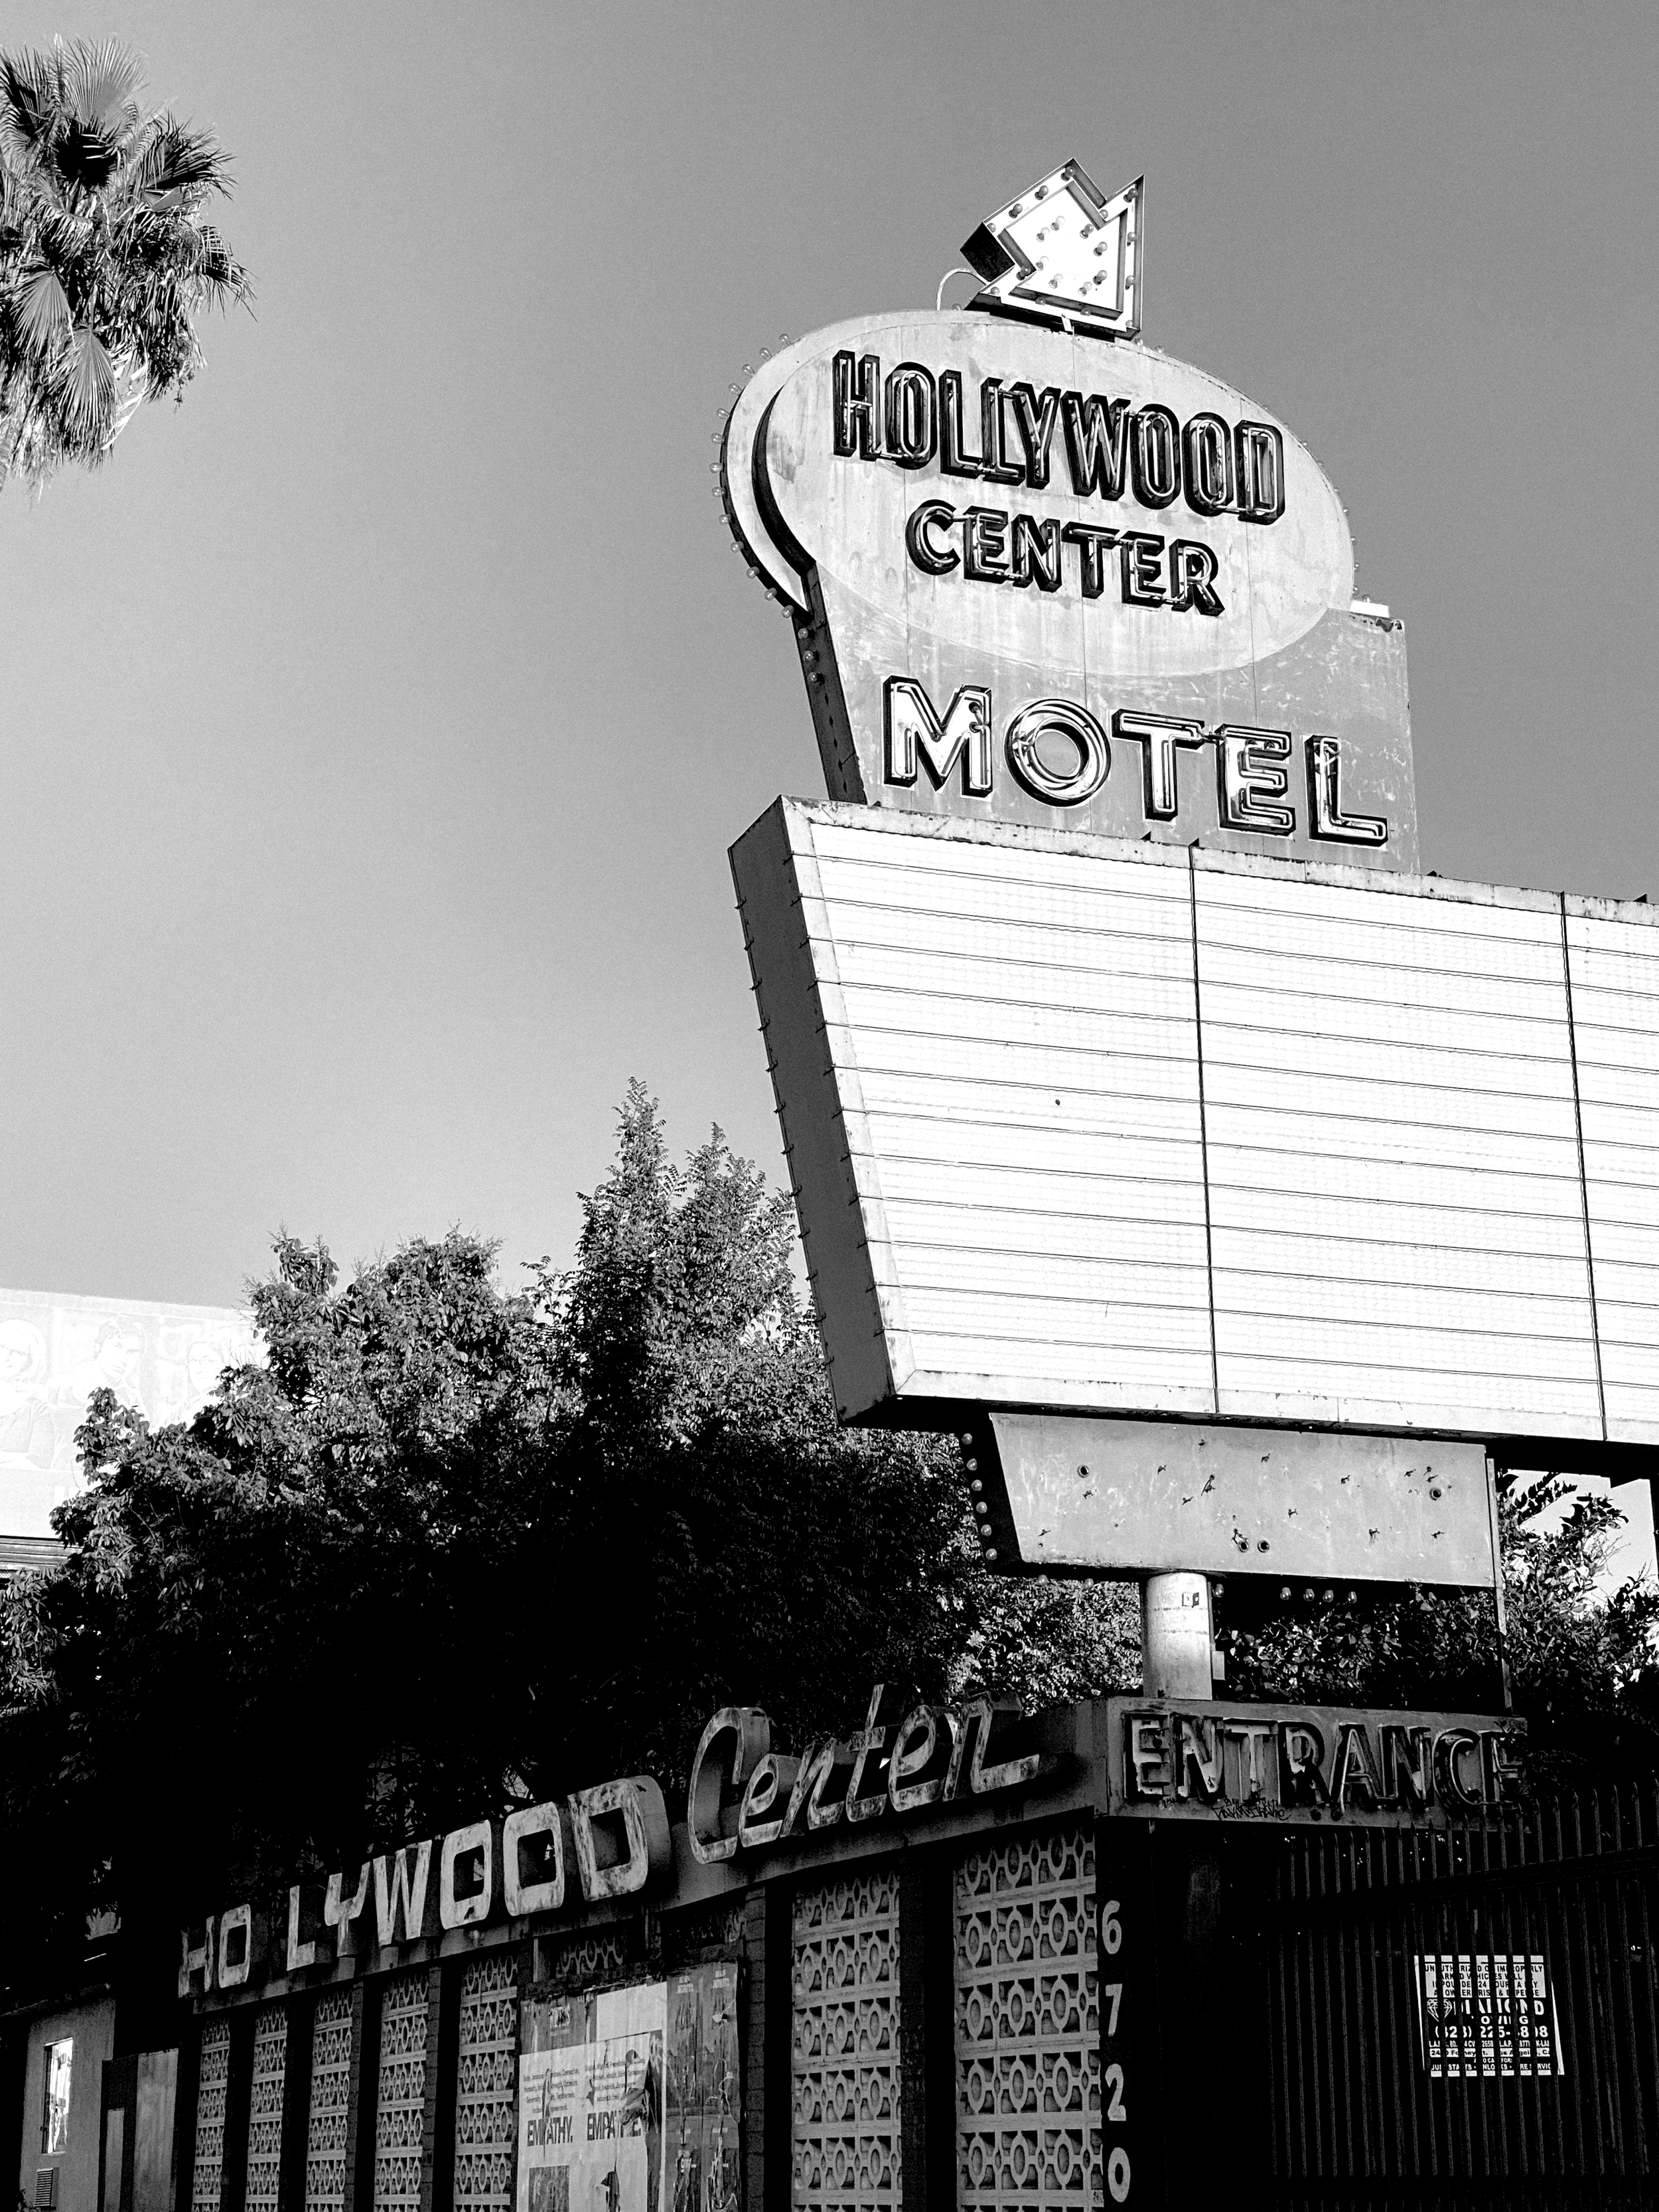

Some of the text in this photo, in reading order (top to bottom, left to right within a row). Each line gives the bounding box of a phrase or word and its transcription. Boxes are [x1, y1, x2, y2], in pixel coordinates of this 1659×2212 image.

[832, 350, 1285, 526] HOLLYWOOD
[904, 498, 1225, 617] CENTER
[883, 673, 1389, 848] MOTEL
[687, 1684, 1040, 1864] Center
[1453, 1998, 1544, 2016] IMOND
[1471, 2015, 1529, 2025] OIG
[1480, 2025, 1548, 2038] 225-88
